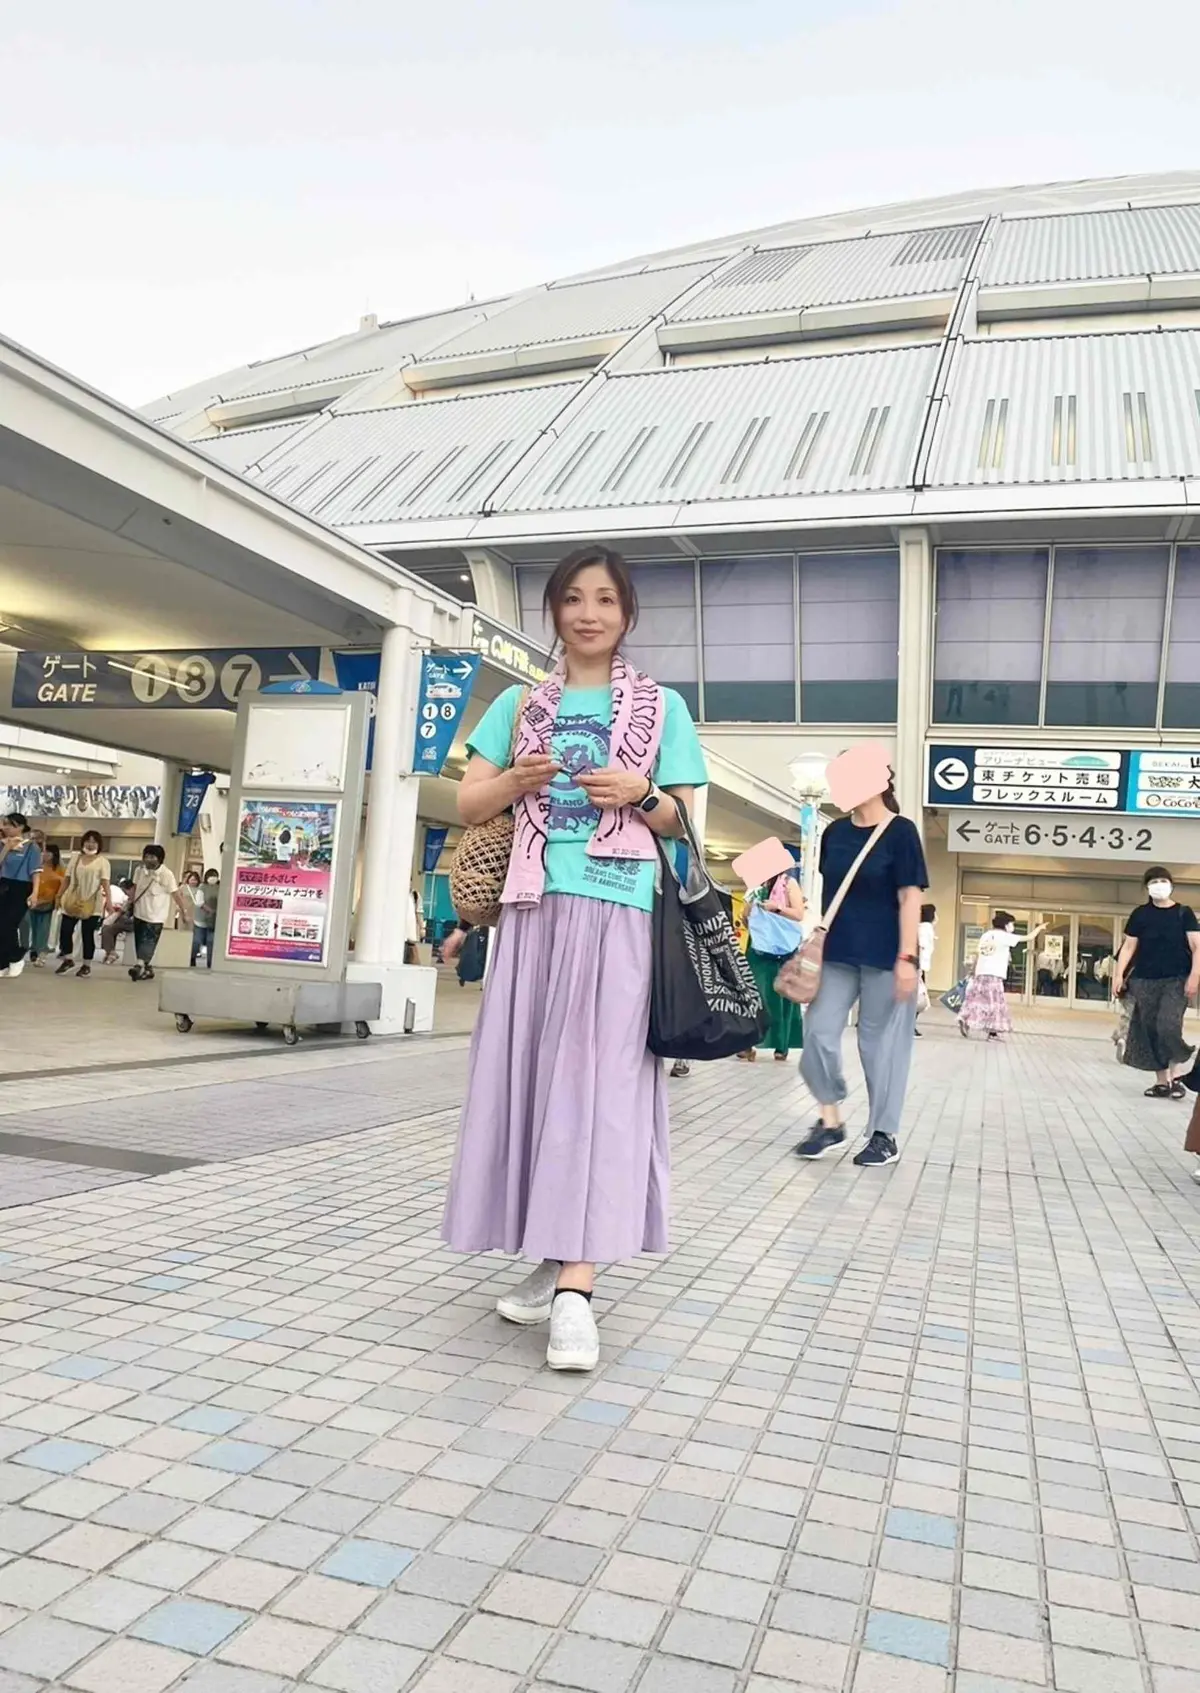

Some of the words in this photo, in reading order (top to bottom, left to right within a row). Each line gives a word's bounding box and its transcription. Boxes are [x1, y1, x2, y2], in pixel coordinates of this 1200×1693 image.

[42, 655, 97, 678] ゲート
[426, 662, 452, 675] ゲート
[182, 661, 206, 697] 8
[231, 663, 253, 697] 7
[37, 683, 97, 703] GATE
[427, 706, 433, 717] 1
[444, 706, 452, 717] 8
[425, 725, 433, 736] 7
[186, 794, 200, 808] 73
[981, 788, 1108, 804] フレックスルーム
[985, 821, 1020, 833] ゲート
[984, 834, 1020, 845] GATE
